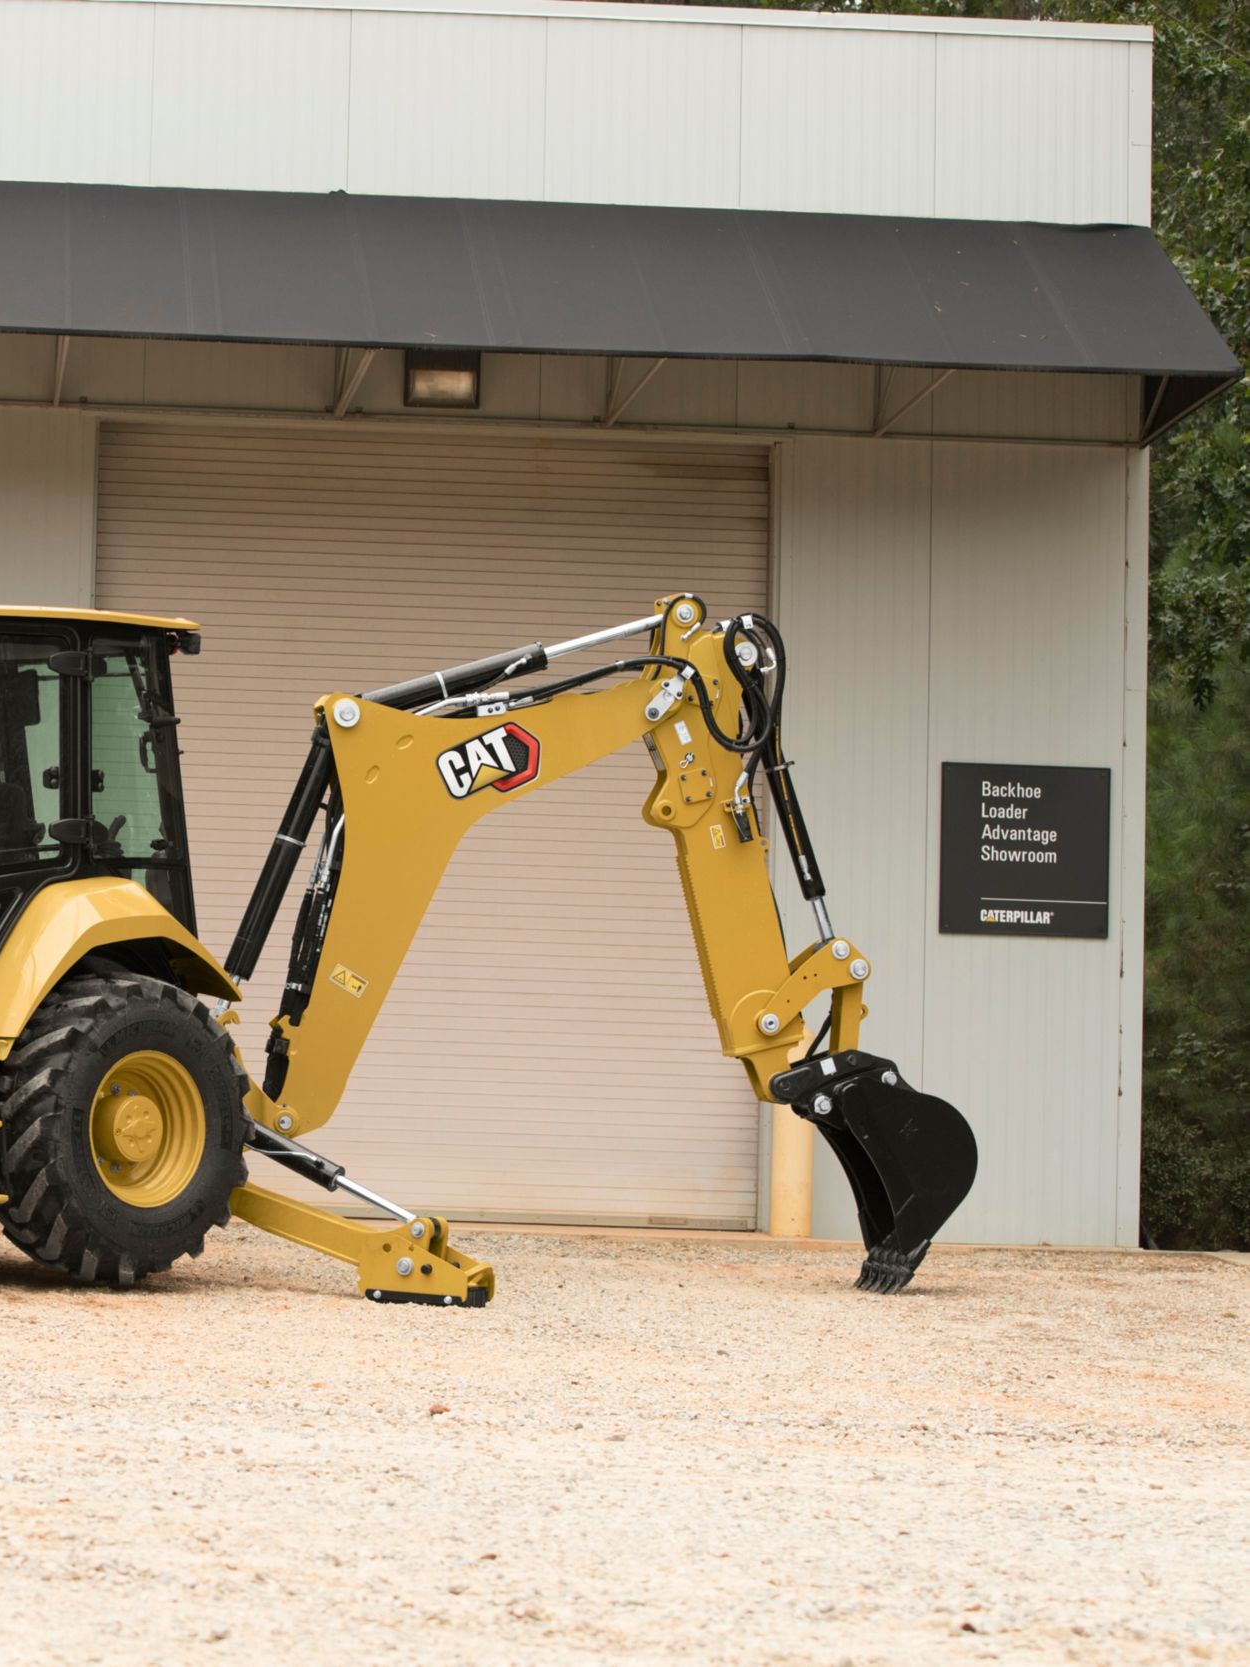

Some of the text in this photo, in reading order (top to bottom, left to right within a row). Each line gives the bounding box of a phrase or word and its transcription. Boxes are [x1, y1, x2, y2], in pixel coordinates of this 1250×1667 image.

[437, 726, 516, 797] CAT
[981, 781, 1041, 798] Backhoe
[981, 802, 1028, 819] Loader
[981, 824, 1057, 844] Advantage
[980, 845, 1057, 863] Showroom
[980, 909, 1051, 924] CATERPILLAR
